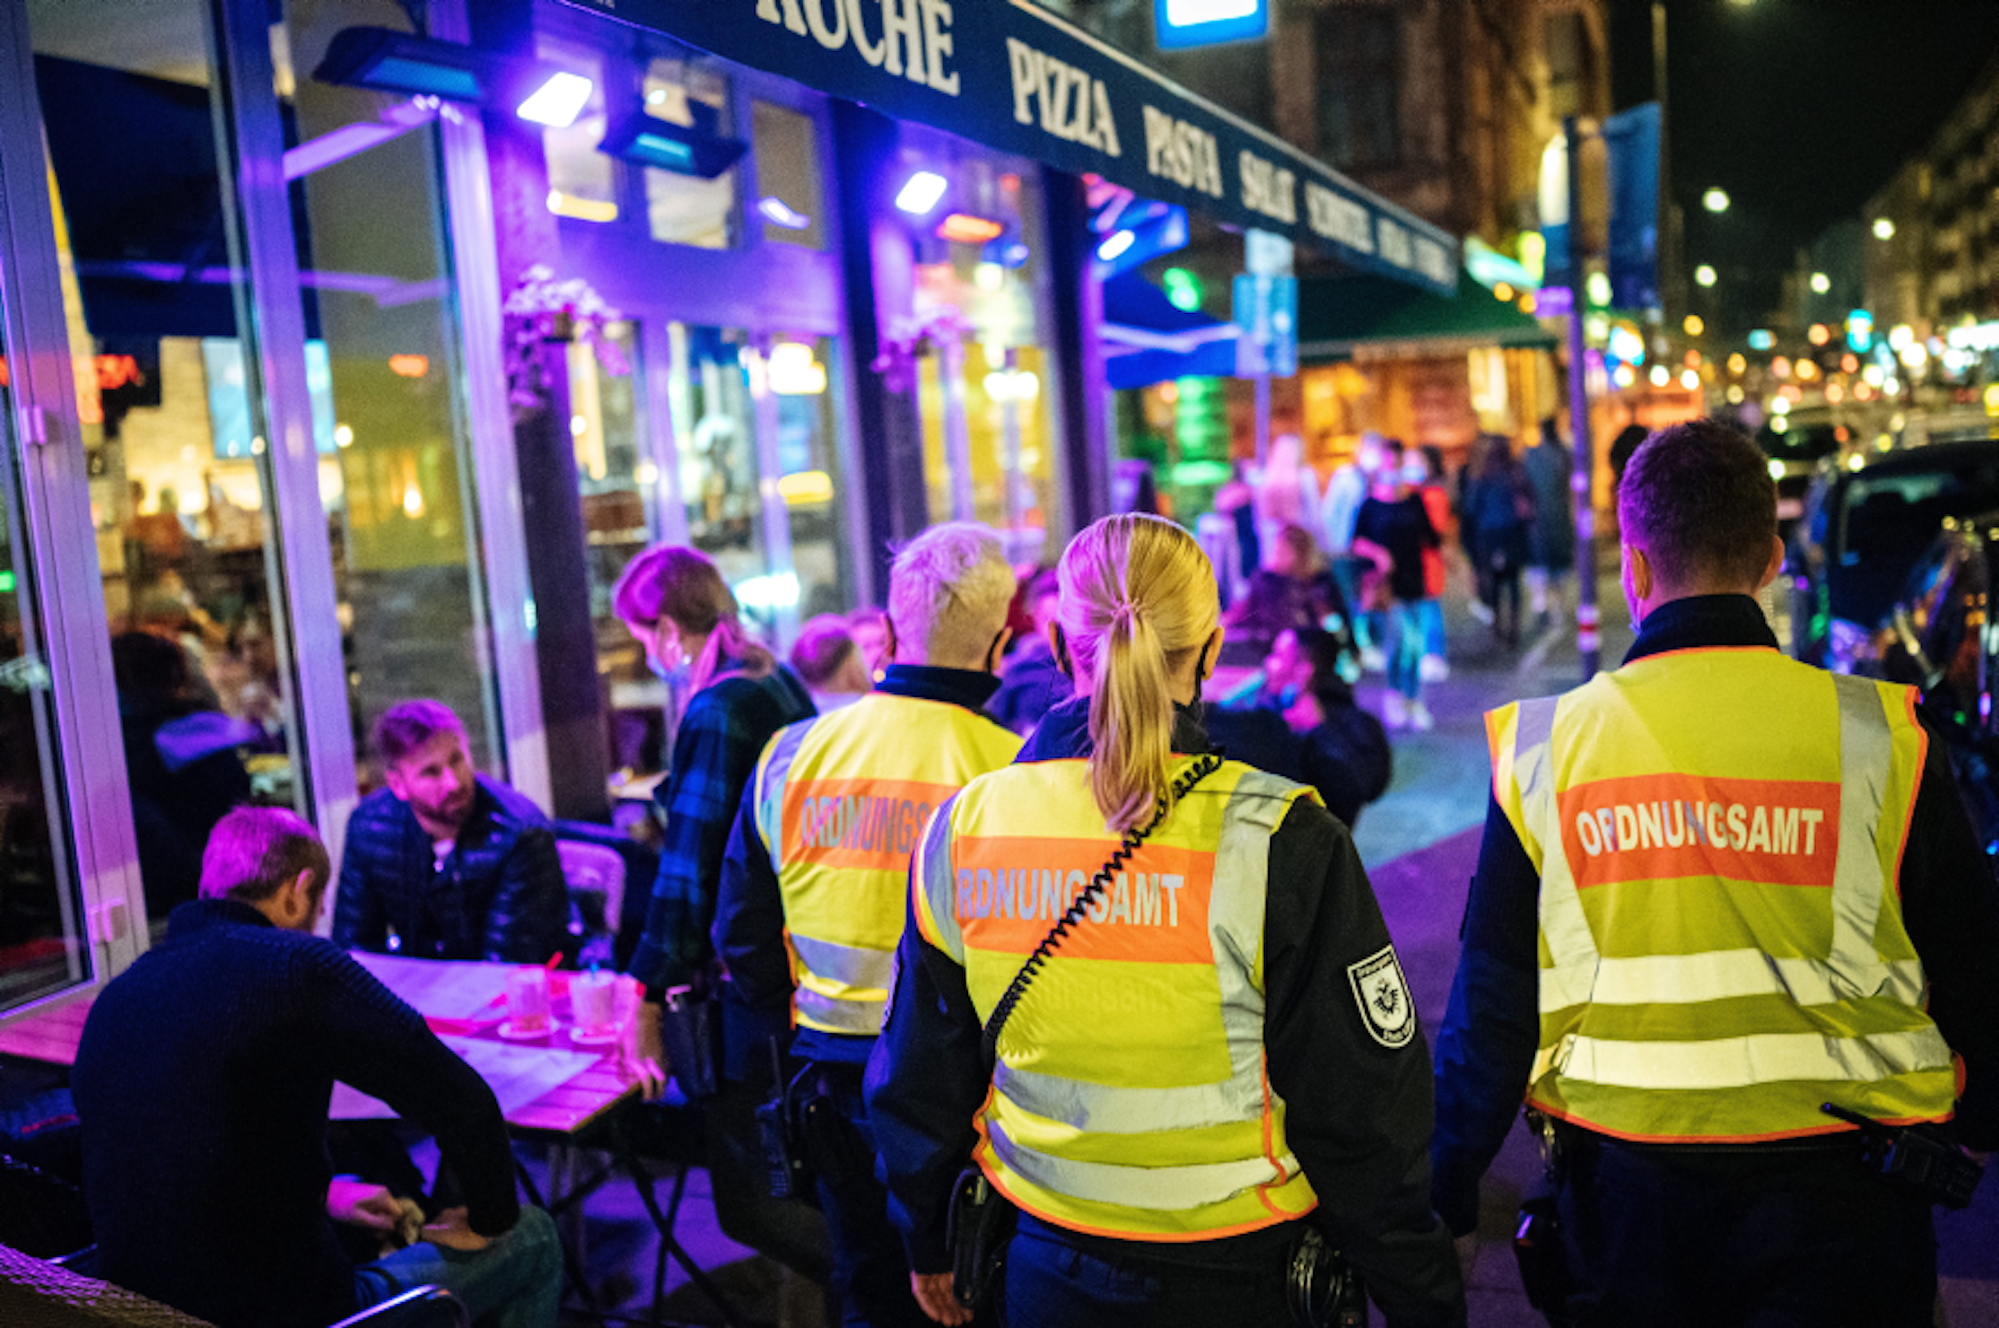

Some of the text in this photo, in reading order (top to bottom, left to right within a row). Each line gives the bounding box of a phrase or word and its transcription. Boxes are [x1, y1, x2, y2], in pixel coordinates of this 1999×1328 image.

[1006, 37, 1121, 157] PIZZA
[1142, 105, 1224, 199] PASTA
[801, 796, 931, 854] ORDNUNGS
[1575, 800, 1824, 856] ORDNUNGSAMT
[957, 867, 1184, 927] RDNUNGSAMT
